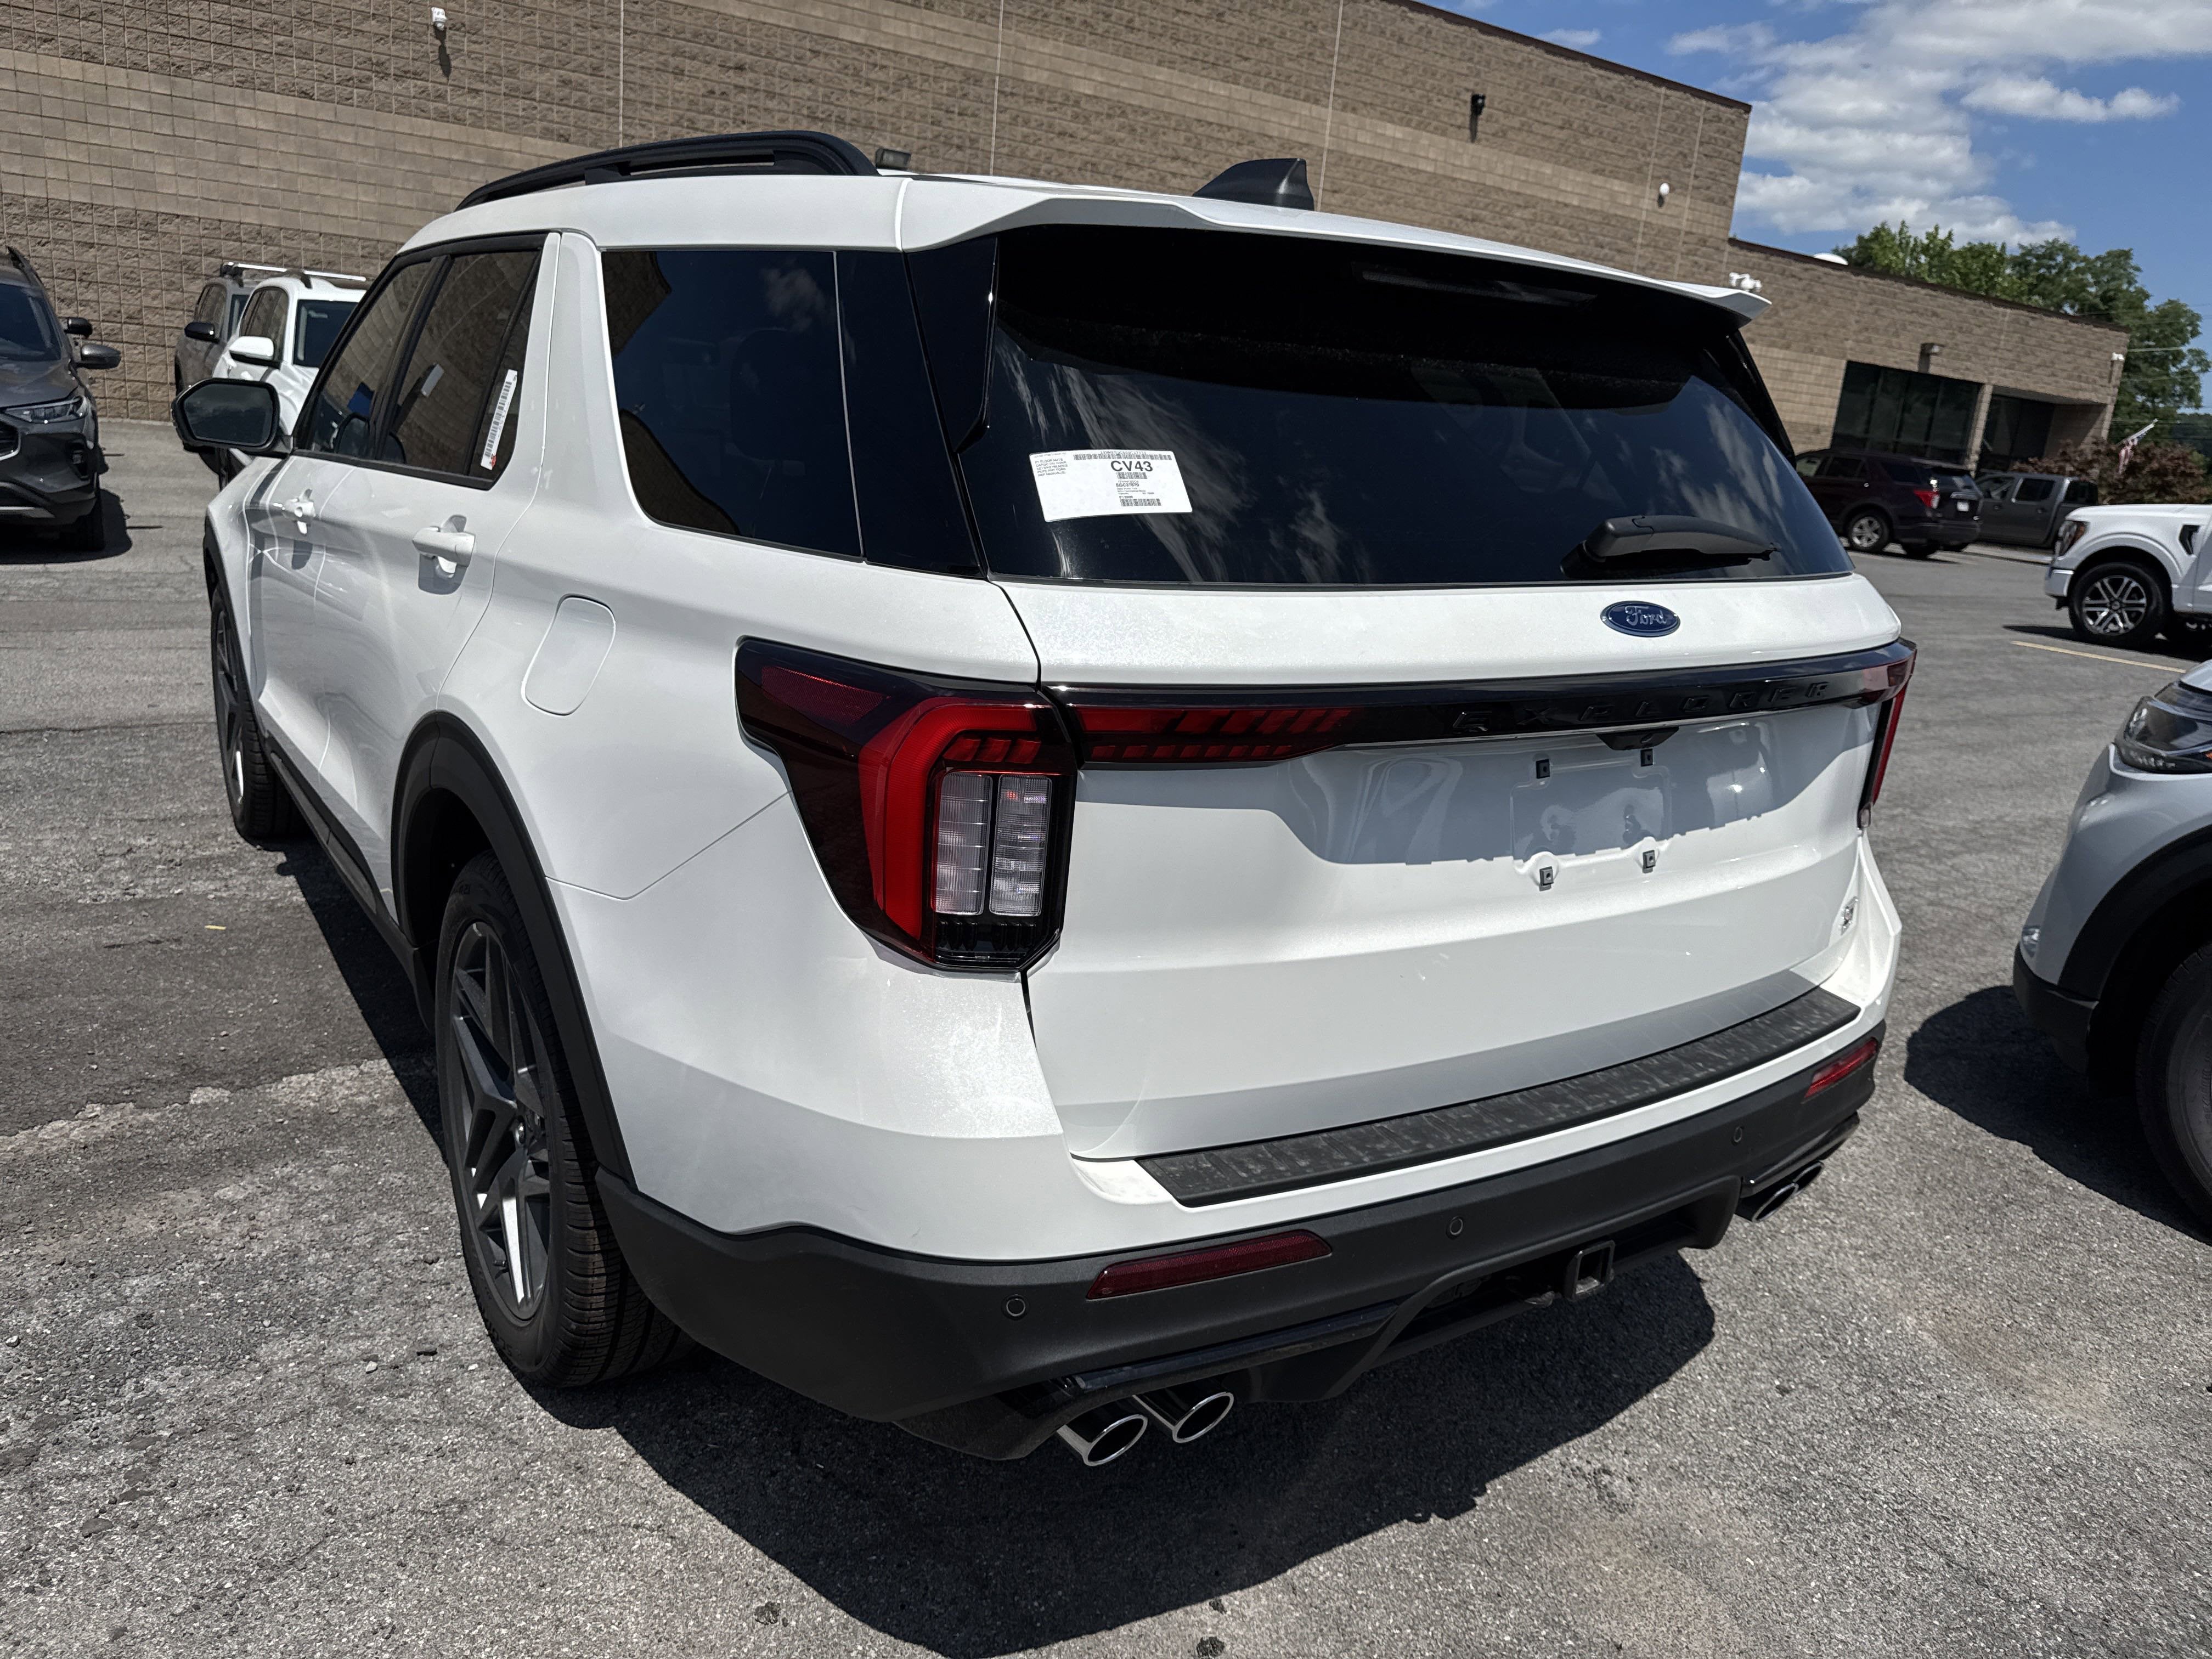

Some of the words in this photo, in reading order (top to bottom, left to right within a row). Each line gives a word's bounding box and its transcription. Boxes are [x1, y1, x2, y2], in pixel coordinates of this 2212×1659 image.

[1110, 460, 1153, 472] CV43
[1624, 605, 1667, 626] Ford
[1452, 681, 1830, 733] EXPLORER
